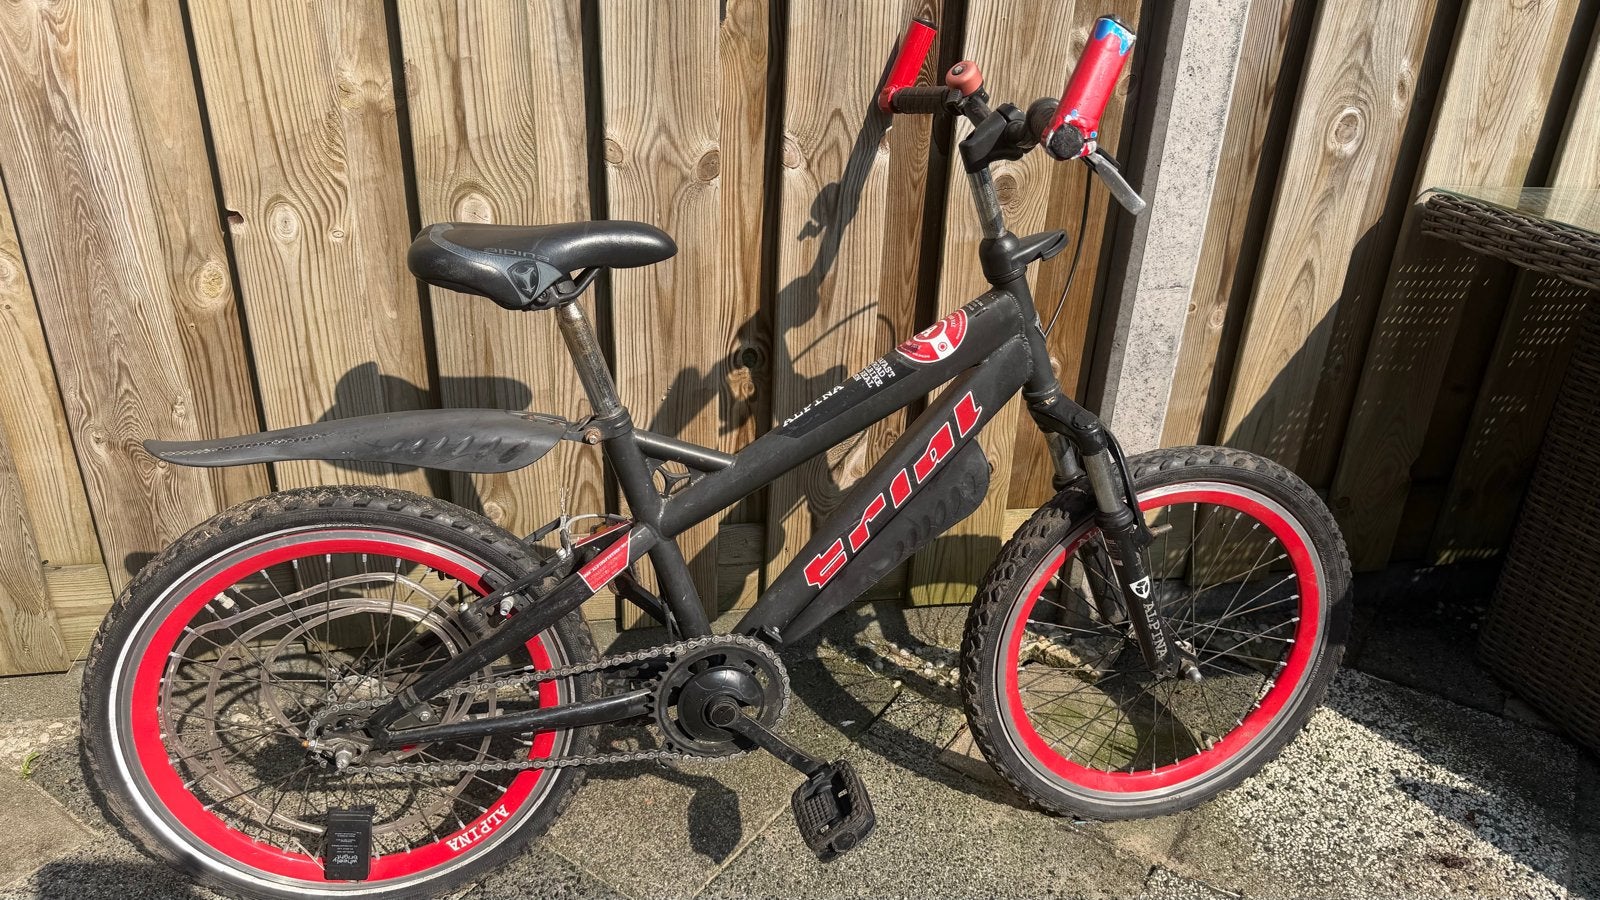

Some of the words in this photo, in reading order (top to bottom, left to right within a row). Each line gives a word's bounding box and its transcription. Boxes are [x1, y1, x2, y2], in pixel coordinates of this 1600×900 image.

[803, 391, 982, 589] trial
[1143, 601, 1168, 660] ALPINA
[446, 804, 510, 852] ALPINA
